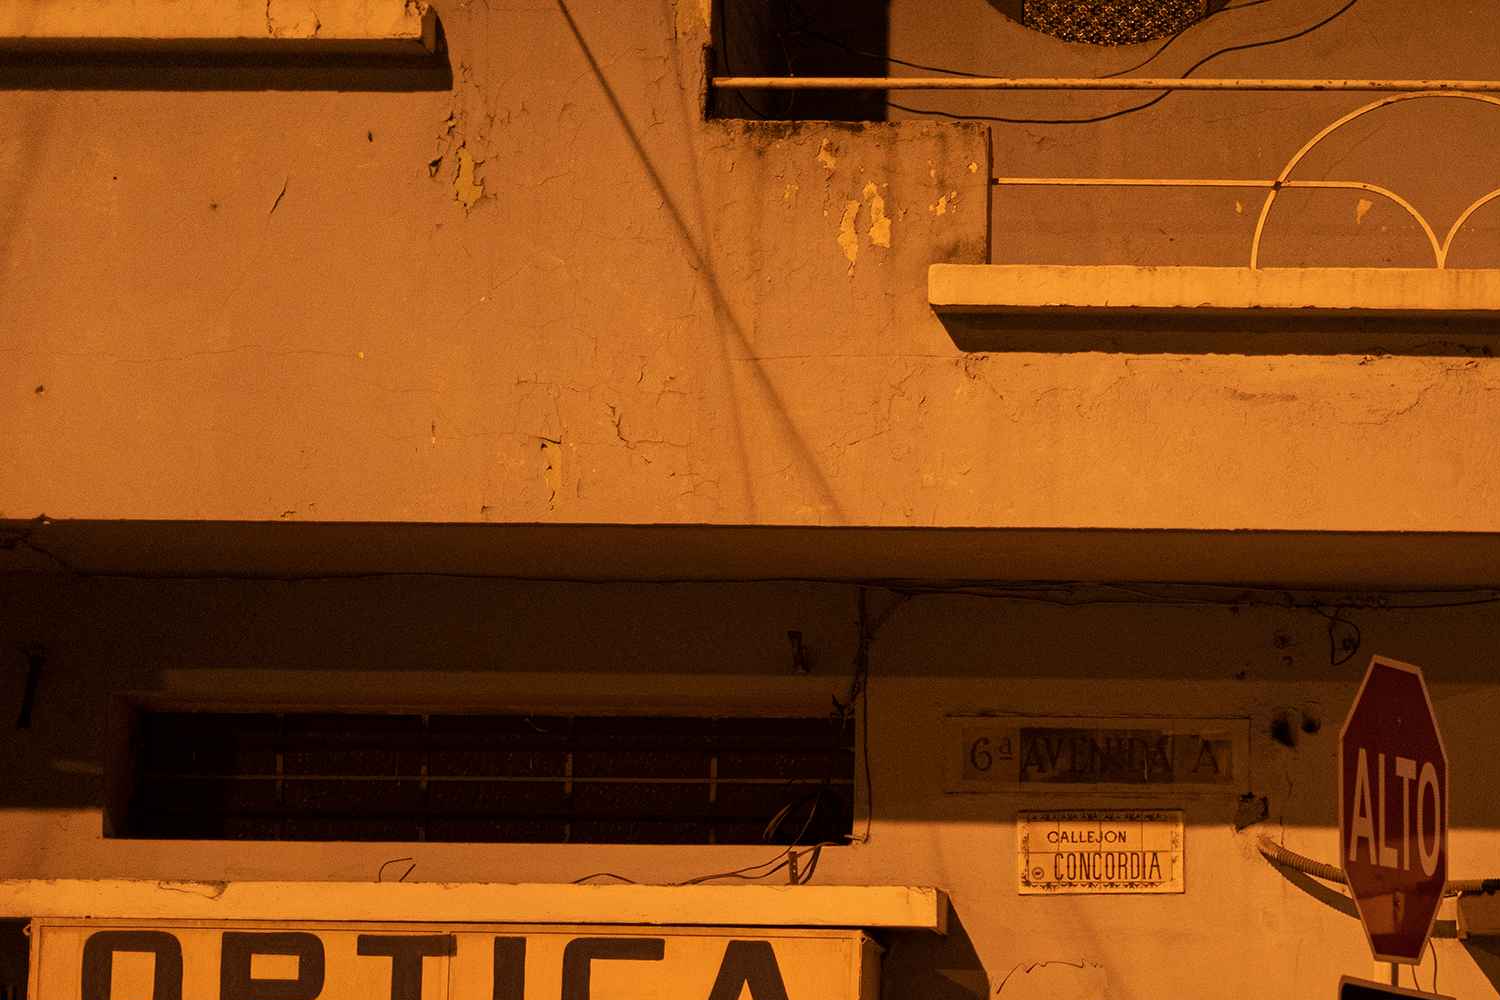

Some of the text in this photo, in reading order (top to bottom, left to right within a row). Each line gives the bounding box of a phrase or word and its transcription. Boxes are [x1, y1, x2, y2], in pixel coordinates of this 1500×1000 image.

[1349, 747, 1442, 877] ALTO
[1046, 830, 1128, 844] CALLEJON
[1053, 852, 1163, 881] CONCORDIA
